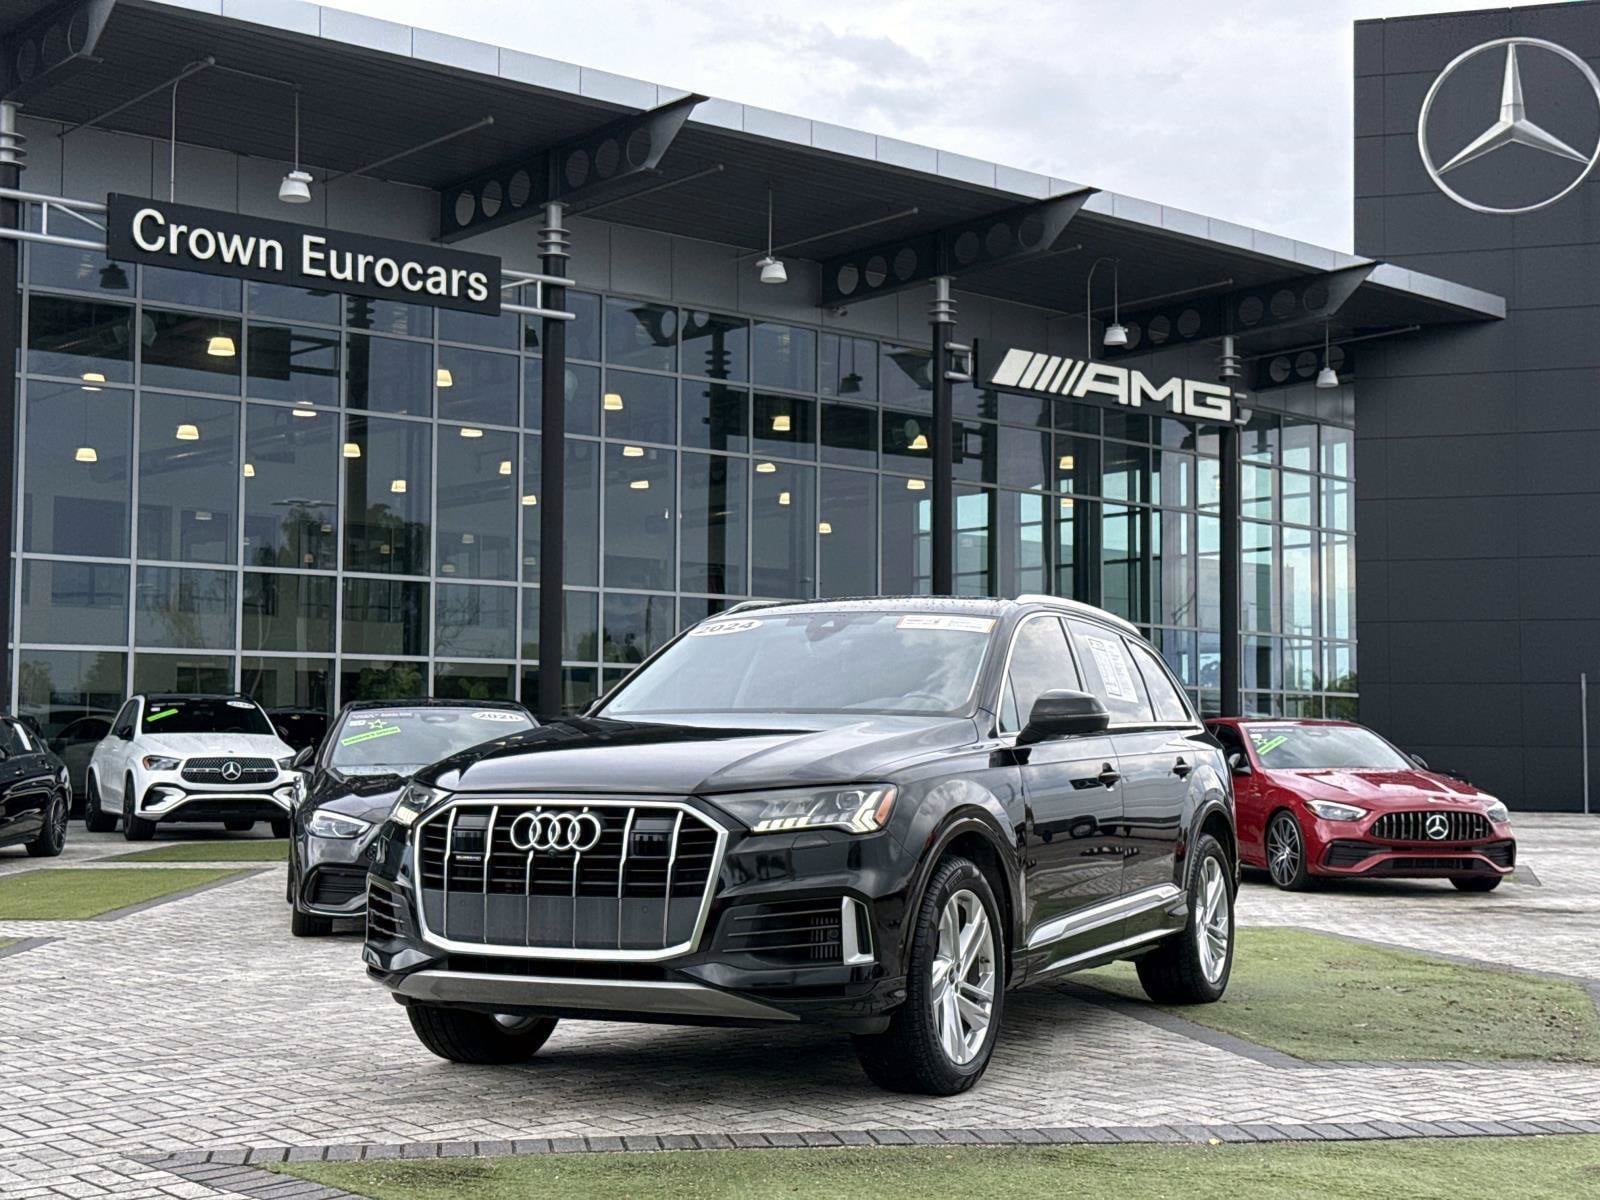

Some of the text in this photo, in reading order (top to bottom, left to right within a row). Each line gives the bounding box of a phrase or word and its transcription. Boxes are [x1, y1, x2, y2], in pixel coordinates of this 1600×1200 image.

[132, 208, 488, 301] Crown Eurocars
[1072, 362, 1231, 422] AMG
